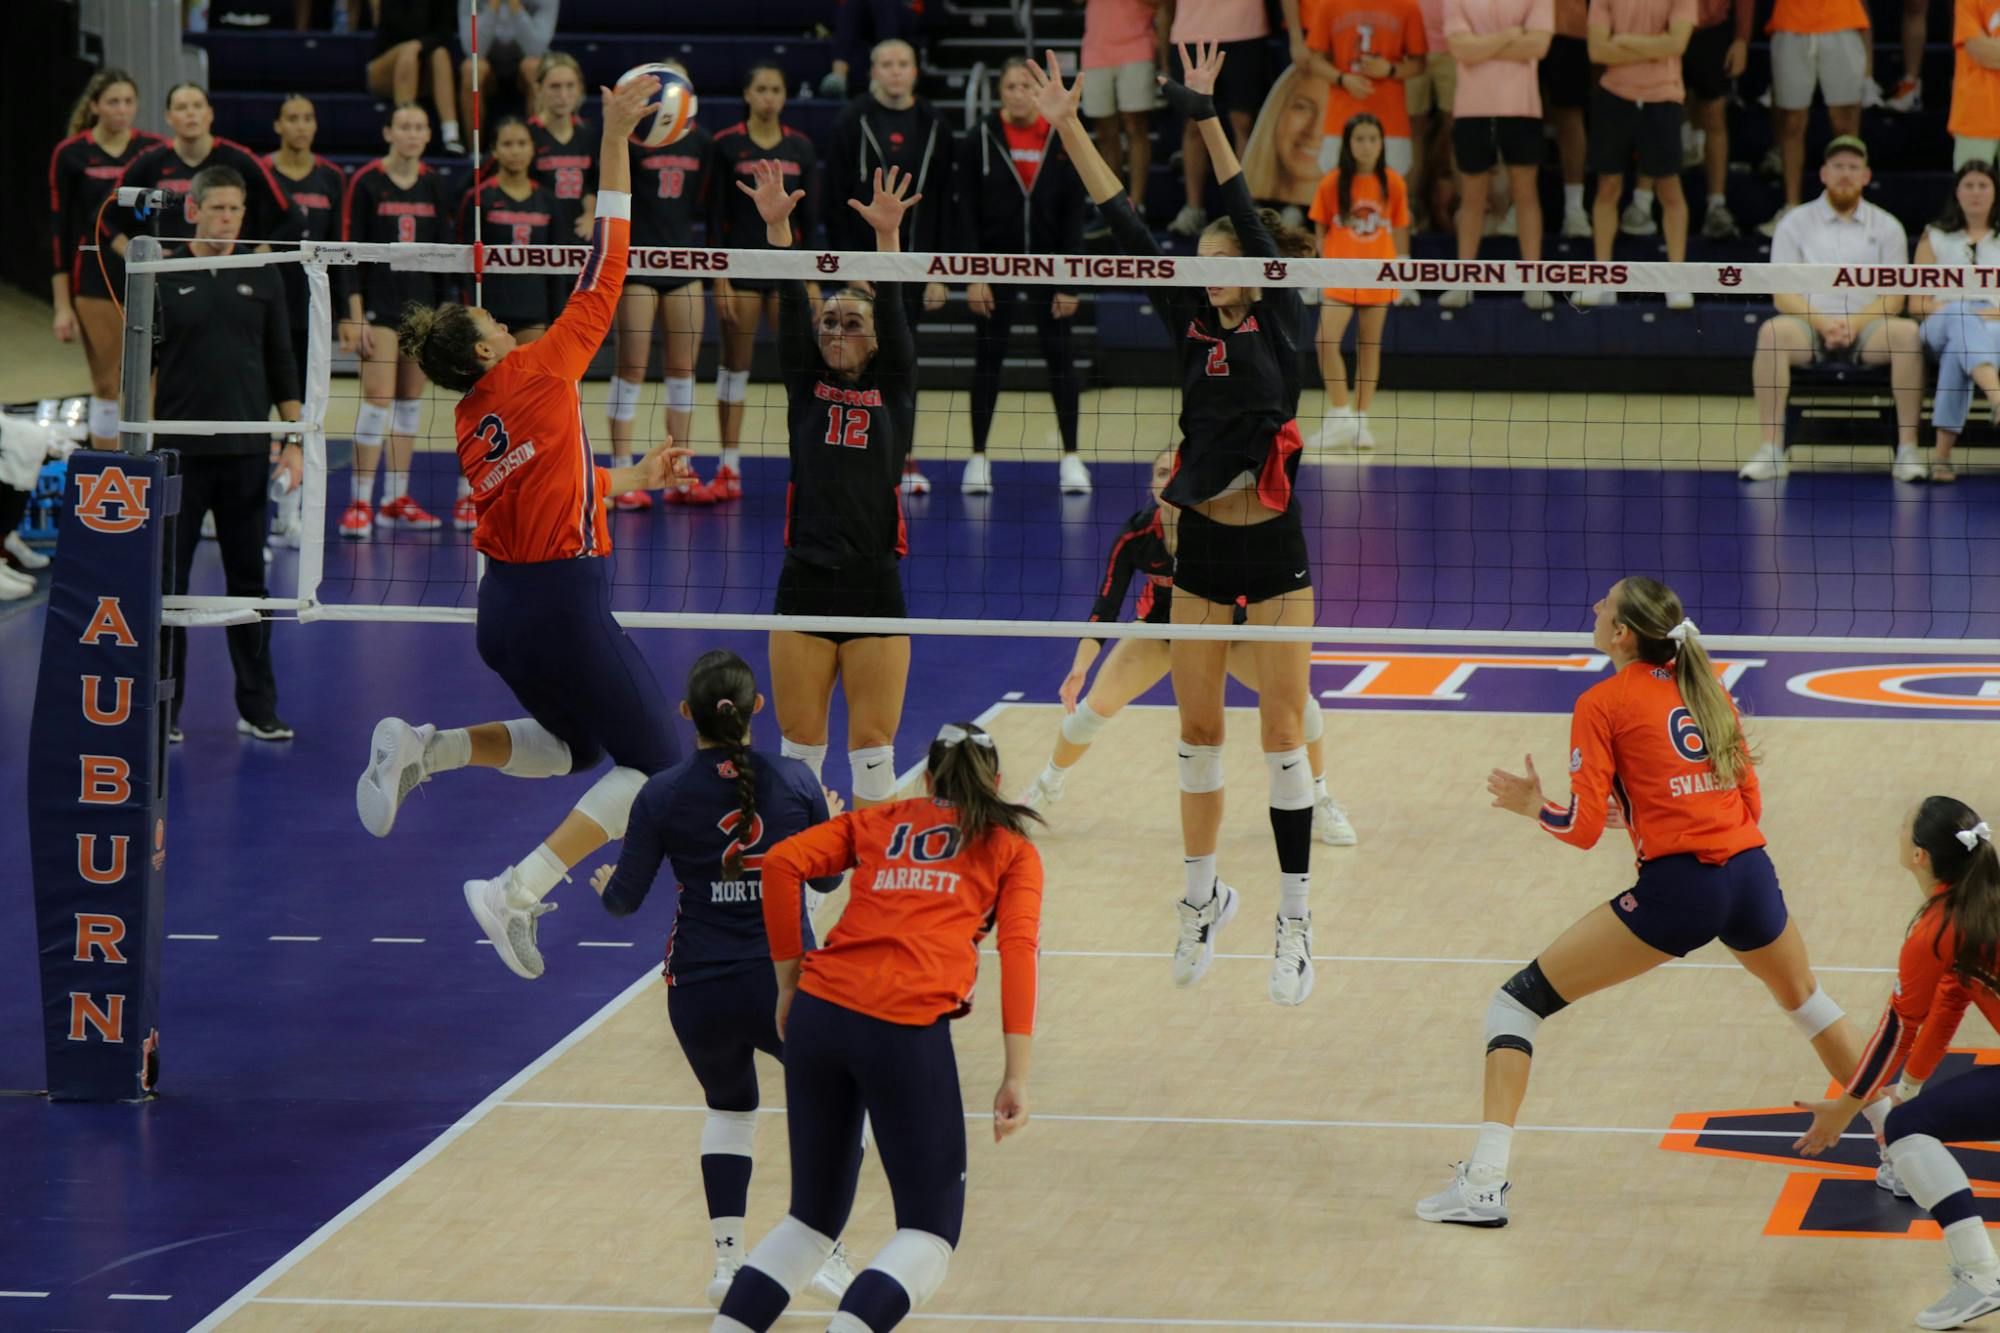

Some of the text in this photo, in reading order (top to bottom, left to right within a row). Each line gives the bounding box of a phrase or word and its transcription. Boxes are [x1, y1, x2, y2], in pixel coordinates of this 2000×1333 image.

[485, 247, 591, 266] AUBUR
[927, 256, 1176, 279] AUBURN TIGERS
[1376, 262, 1629, 284] AUBURN TIGERS
[1832, 267, 1965, 288] AUBURN
[1205, 339, 1230, 376] 2
[474, 413, 510, 462] 3
[824, 404, 871, 449] 12
[1667, 706, 1711, 763] 6
[1669, 772, 1738, 797] SWAN
[67, 596, 138, 1044] AUBURN
[717, 808, 764, 871] 2
[885, 822, 963, 864] 10
[872, 868, 961, 894] BARRETT
